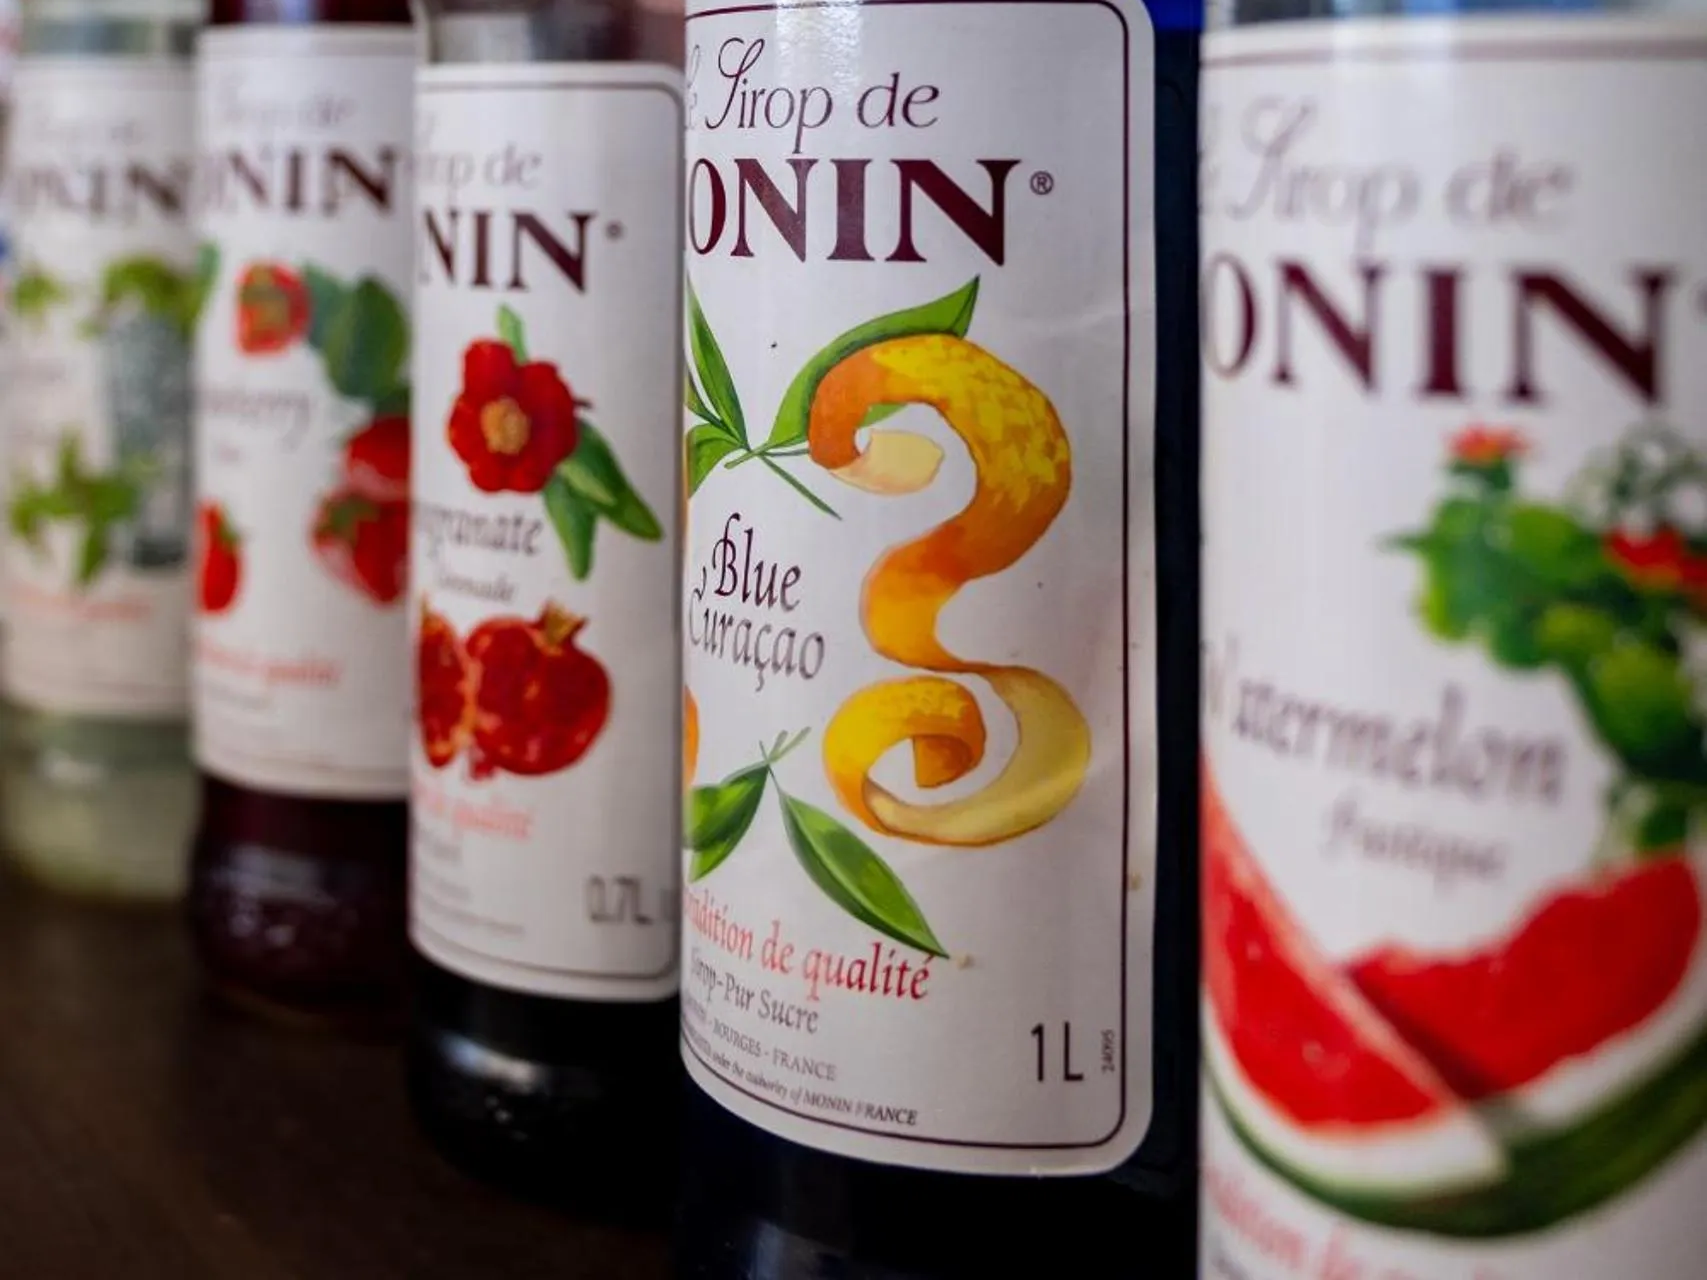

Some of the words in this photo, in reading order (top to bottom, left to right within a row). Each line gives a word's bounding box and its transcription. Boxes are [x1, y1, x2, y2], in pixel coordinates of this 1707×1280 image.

[705, 36, 833, 155] Sirop
[856, 72, 941, 129] de
[711, 511, 802, 613] Blue
[688, 565, 826, 693] Curaçao
[761, 919, 796, 975] de
[803, 940, 936, 1004] qualité
[757, 988, 820, 1036] Sucre
[773, 1048, 837, 1082] FRANCE
[804, 1092, 851, 1114] MONIN
[856, 1099, 919, 1126] FRANCE
